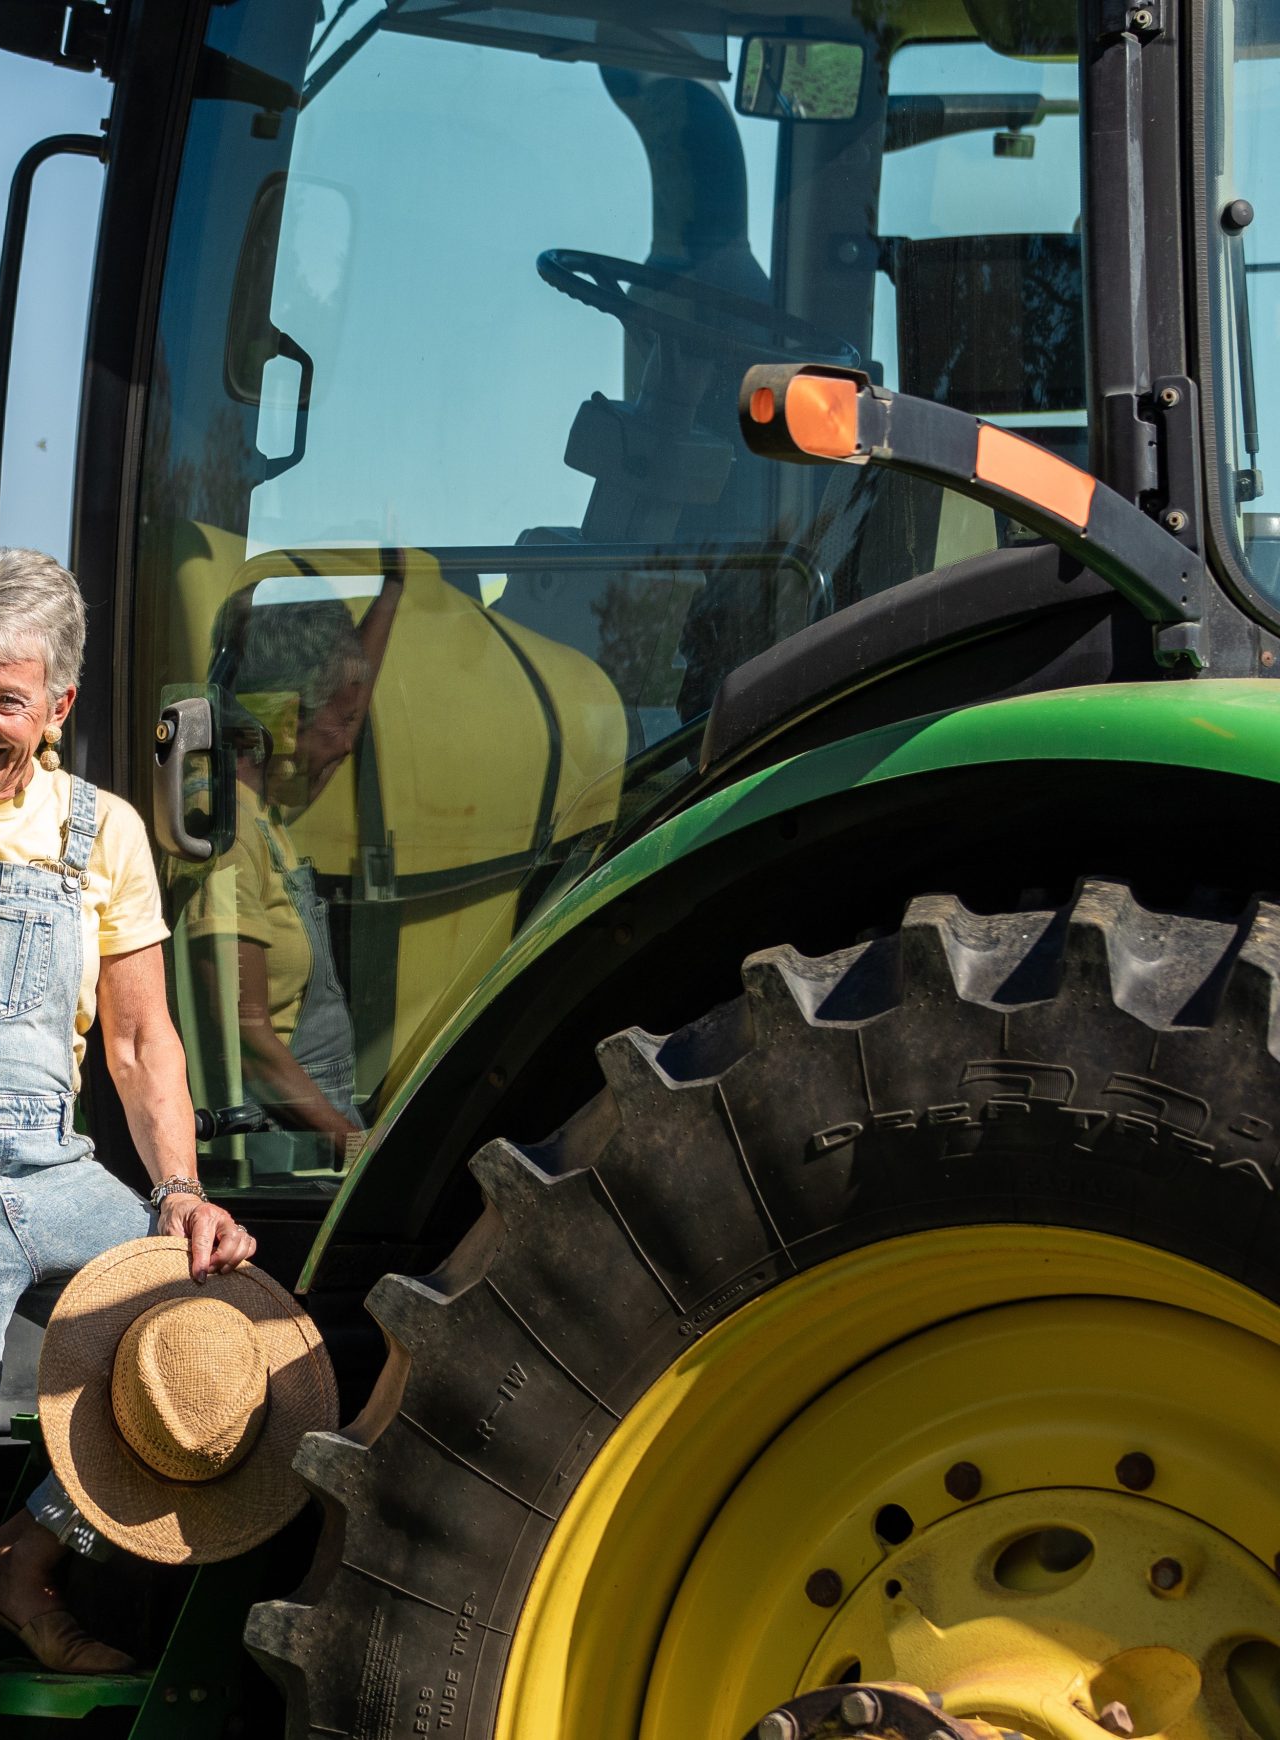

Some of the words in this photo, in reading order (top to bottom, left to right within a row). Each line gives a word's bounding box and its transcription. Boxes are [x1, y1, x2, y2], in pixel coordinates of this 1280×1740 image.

[475, 1361, 528, 1440] R-1W
[435, 1669, 461, 1730] TUBE
[451, 1602, 479, 1657] TYPE
